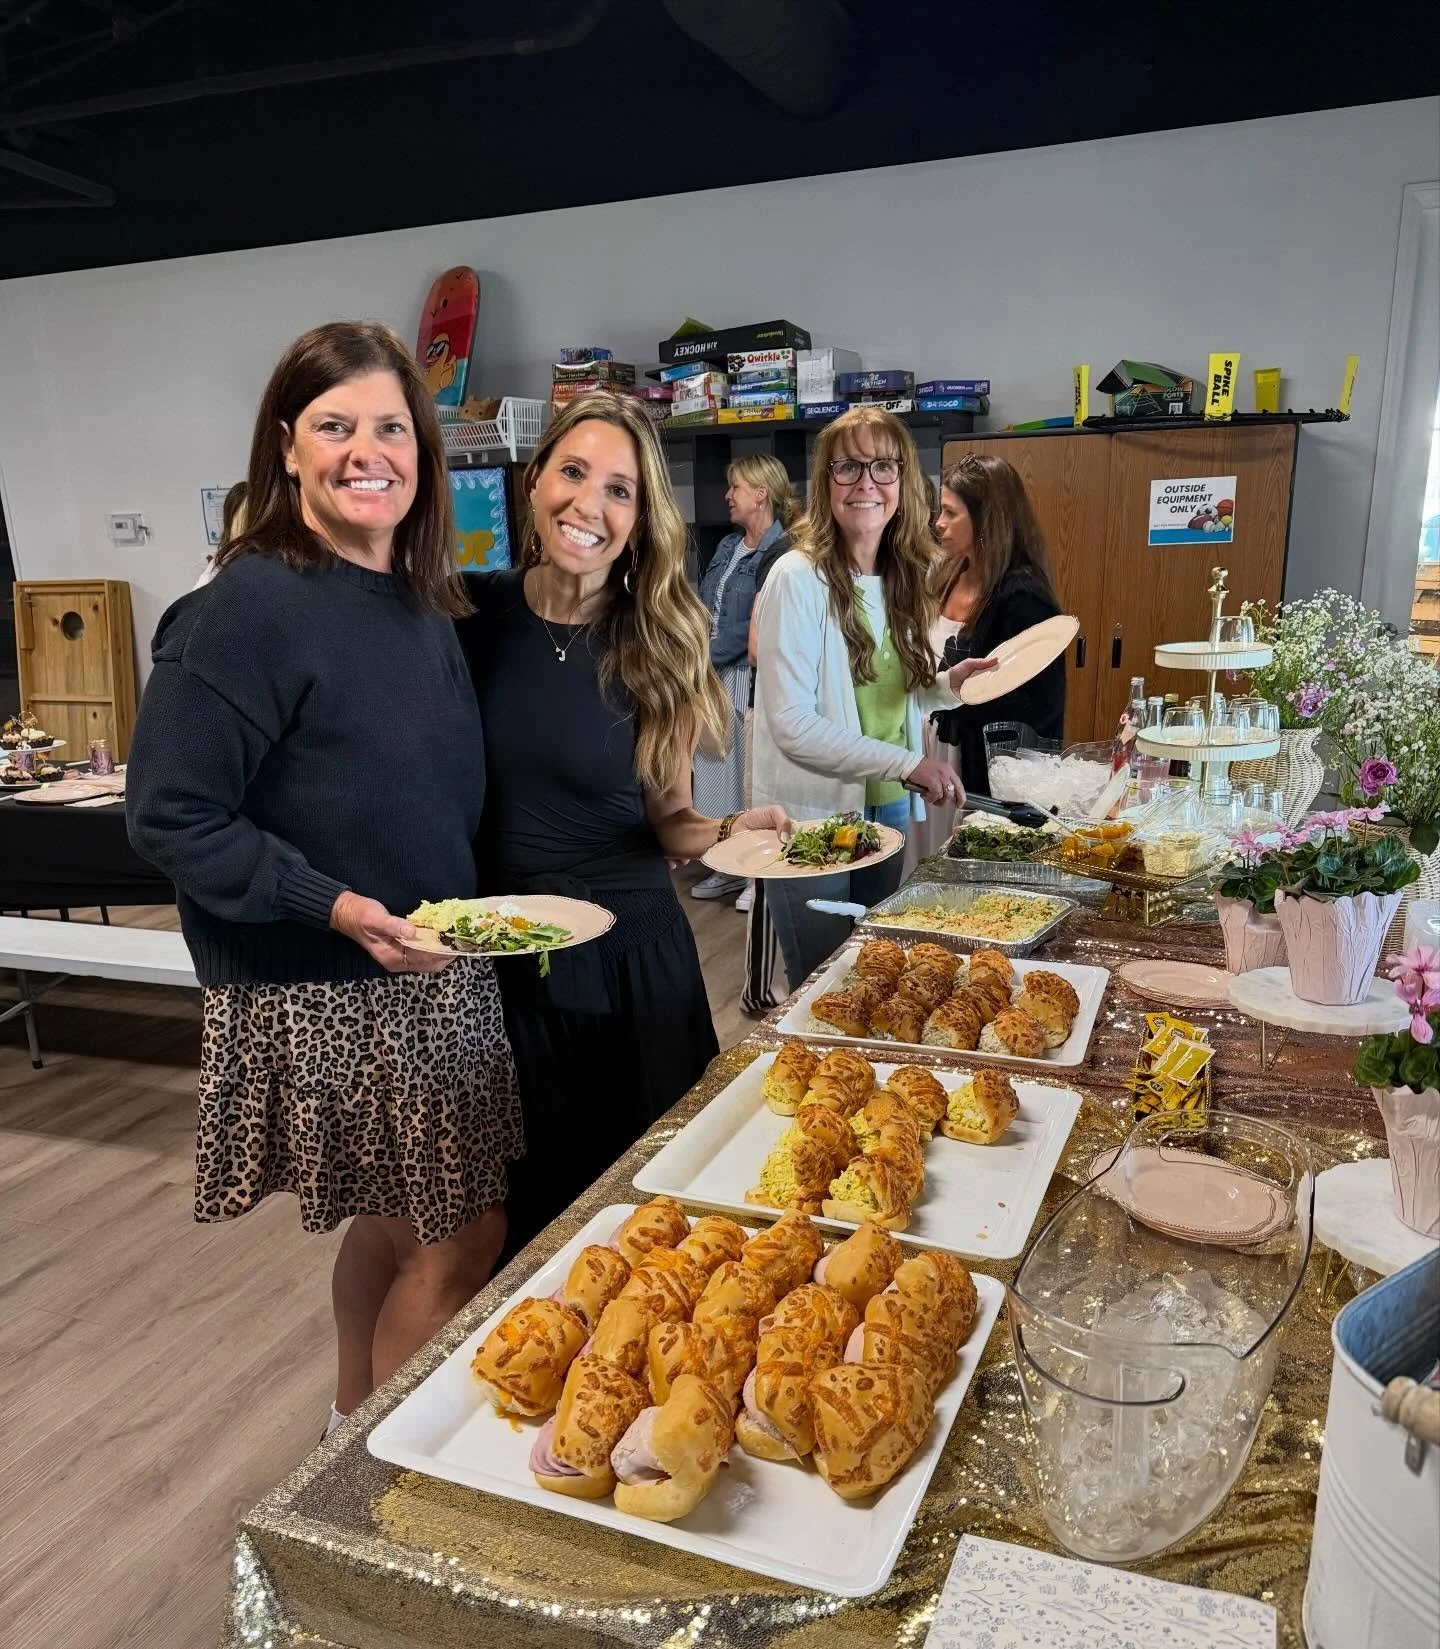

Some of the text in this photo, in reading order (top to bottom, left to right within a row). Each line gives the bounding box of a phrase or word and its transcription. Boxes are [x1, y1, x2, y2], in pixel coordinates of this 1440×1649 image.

[674, 343, 706, 357] HOCKEY
[747, 352, 781, 363] Qwirkle
[1222, 360, 1232, 397] SPIKE
[1211, 374, 1222, 405] BALL
[806, 405, 840, 415] SEQUENCE
[1164, 484, 1206, 493] OUTSIDE
[1157, 493, 1213, 504] EQUIPMENT
[1170, 505, 1196, 513] ONLY
